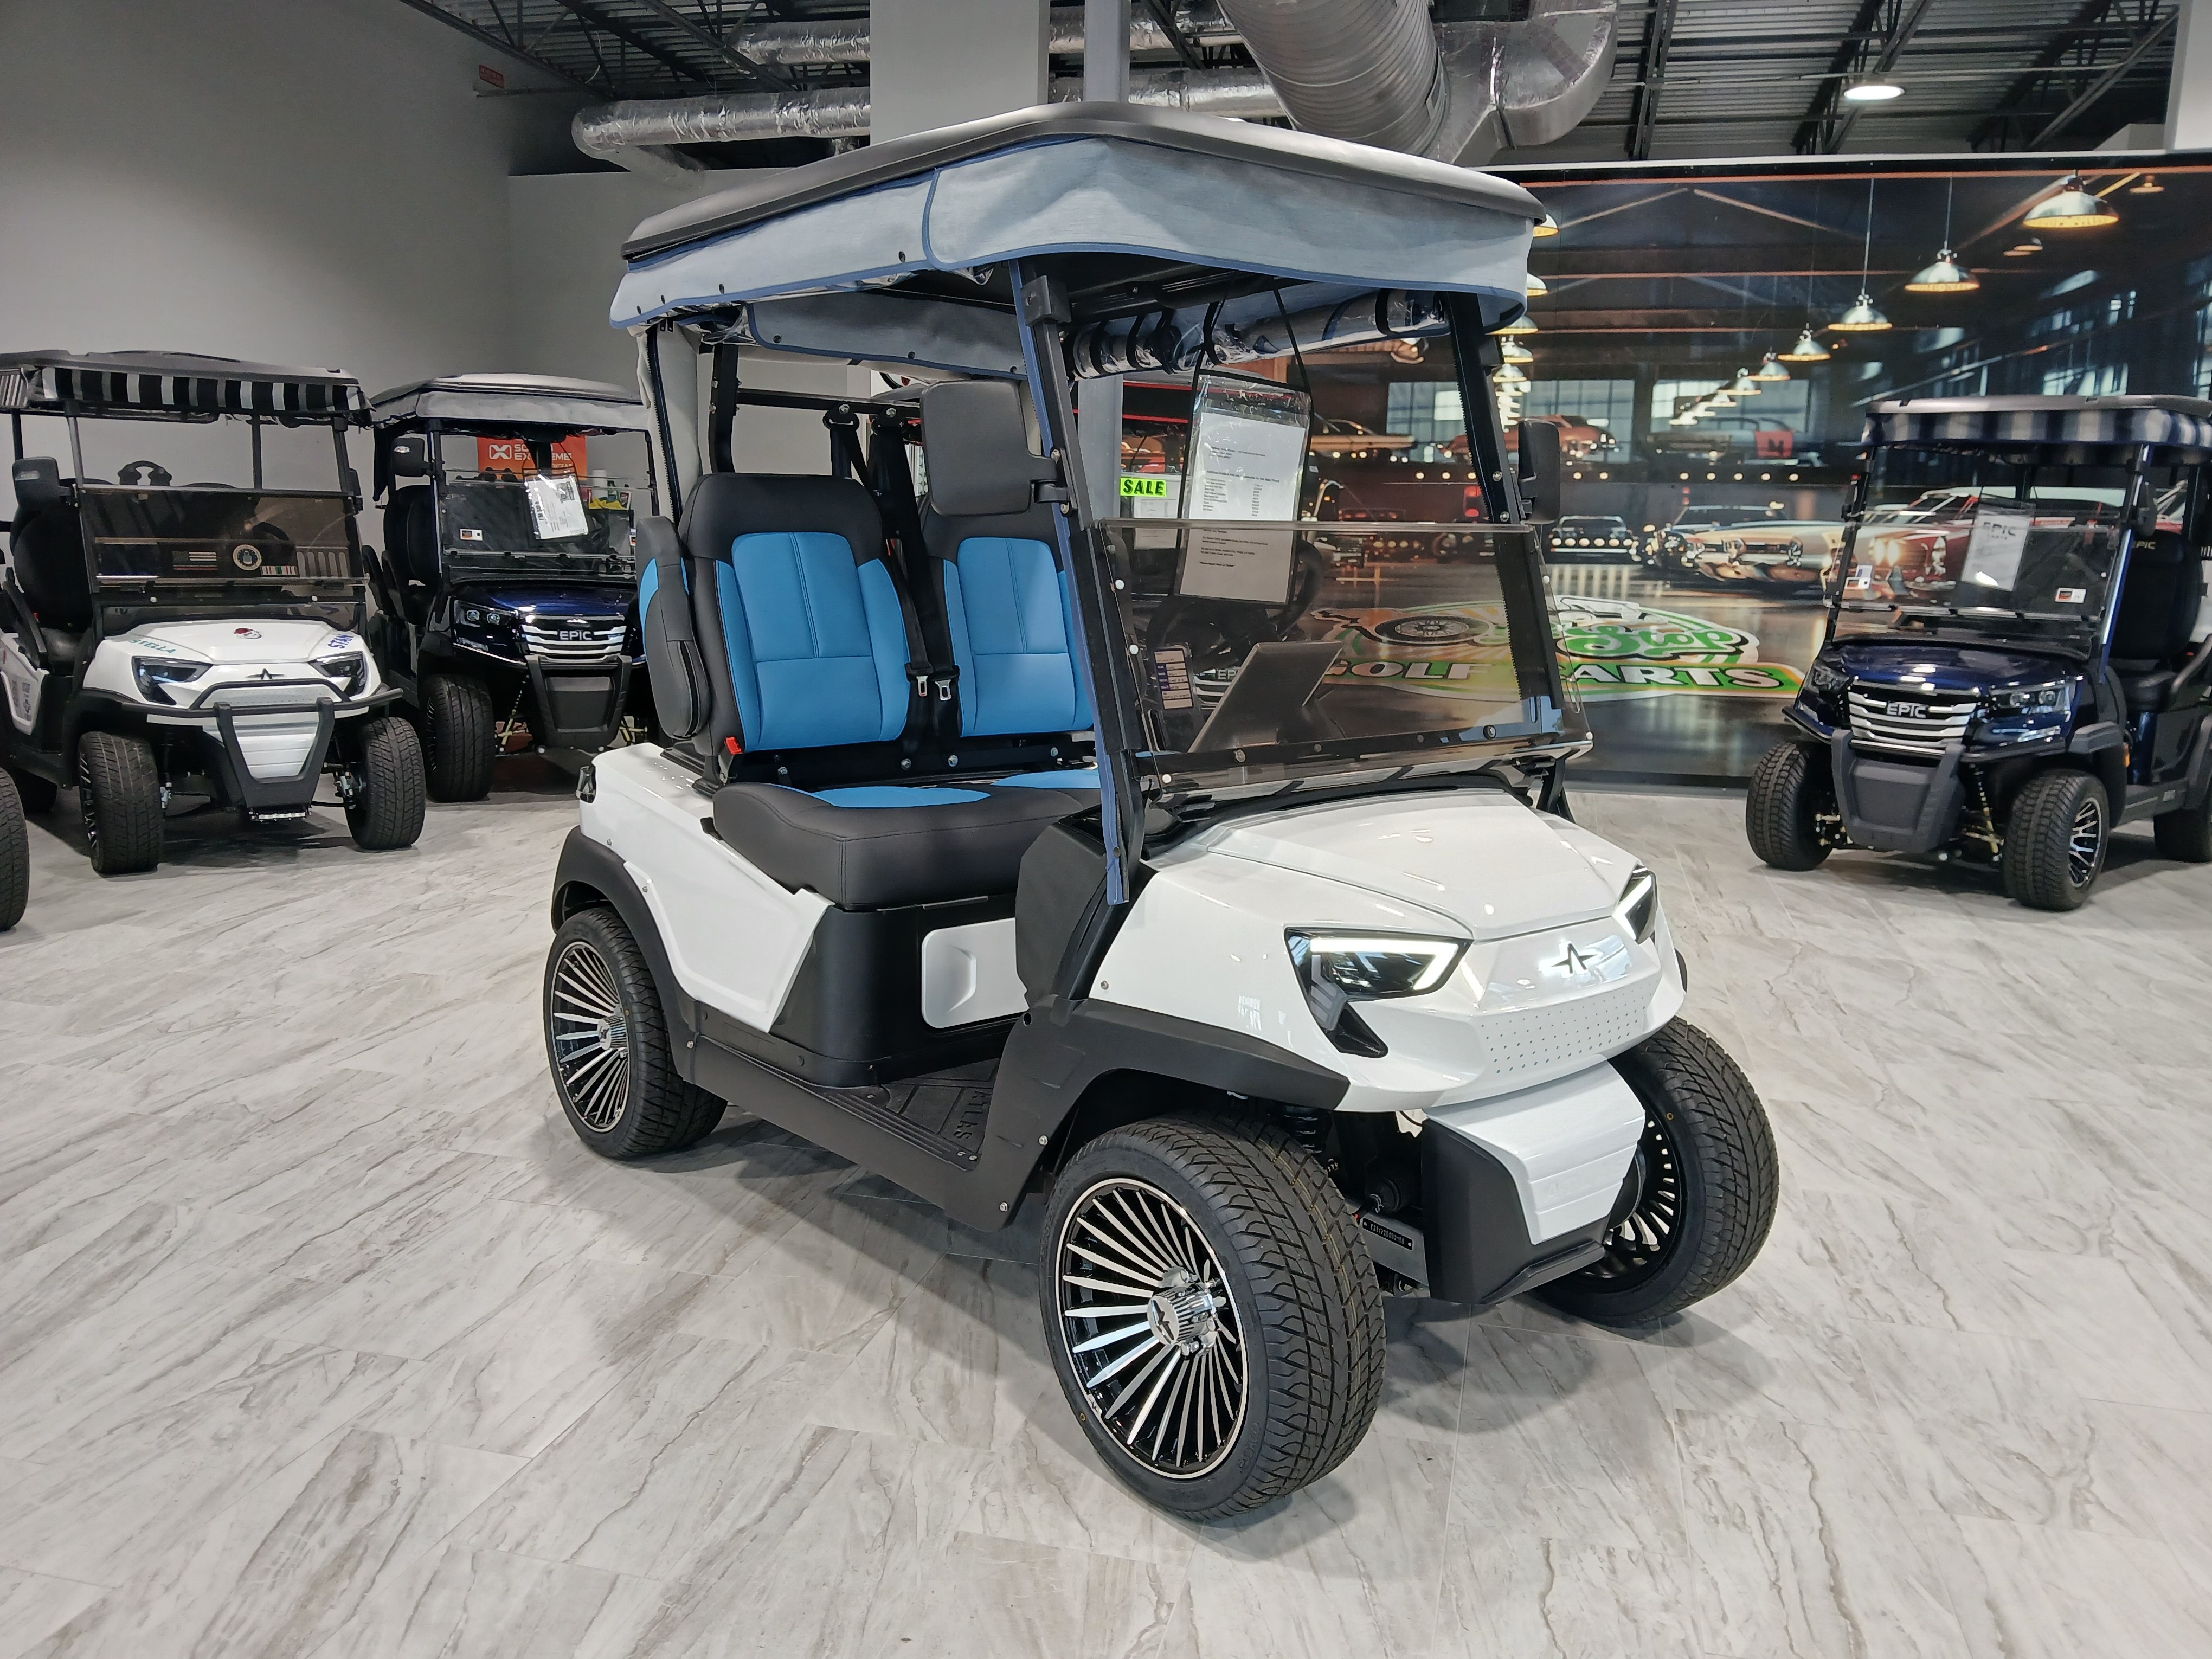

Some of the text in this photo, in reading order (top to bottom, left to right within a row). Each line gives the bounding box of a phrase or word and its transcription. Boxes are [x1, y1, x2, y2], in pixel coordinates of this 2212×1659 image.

[514, 452, 573, 461] EXEME
[1123, 479, 1165, 495] SALE
[2134, 540, 2156, 550] PIC
[559, 631, 593, 640] EPIC
[128, 639, 177, 654] STELLA
[1218, 669, 1237, 681] EP
[1559, 664, 1780, 687] ARTS
[1887, 703, 1926, 718] EPIC
